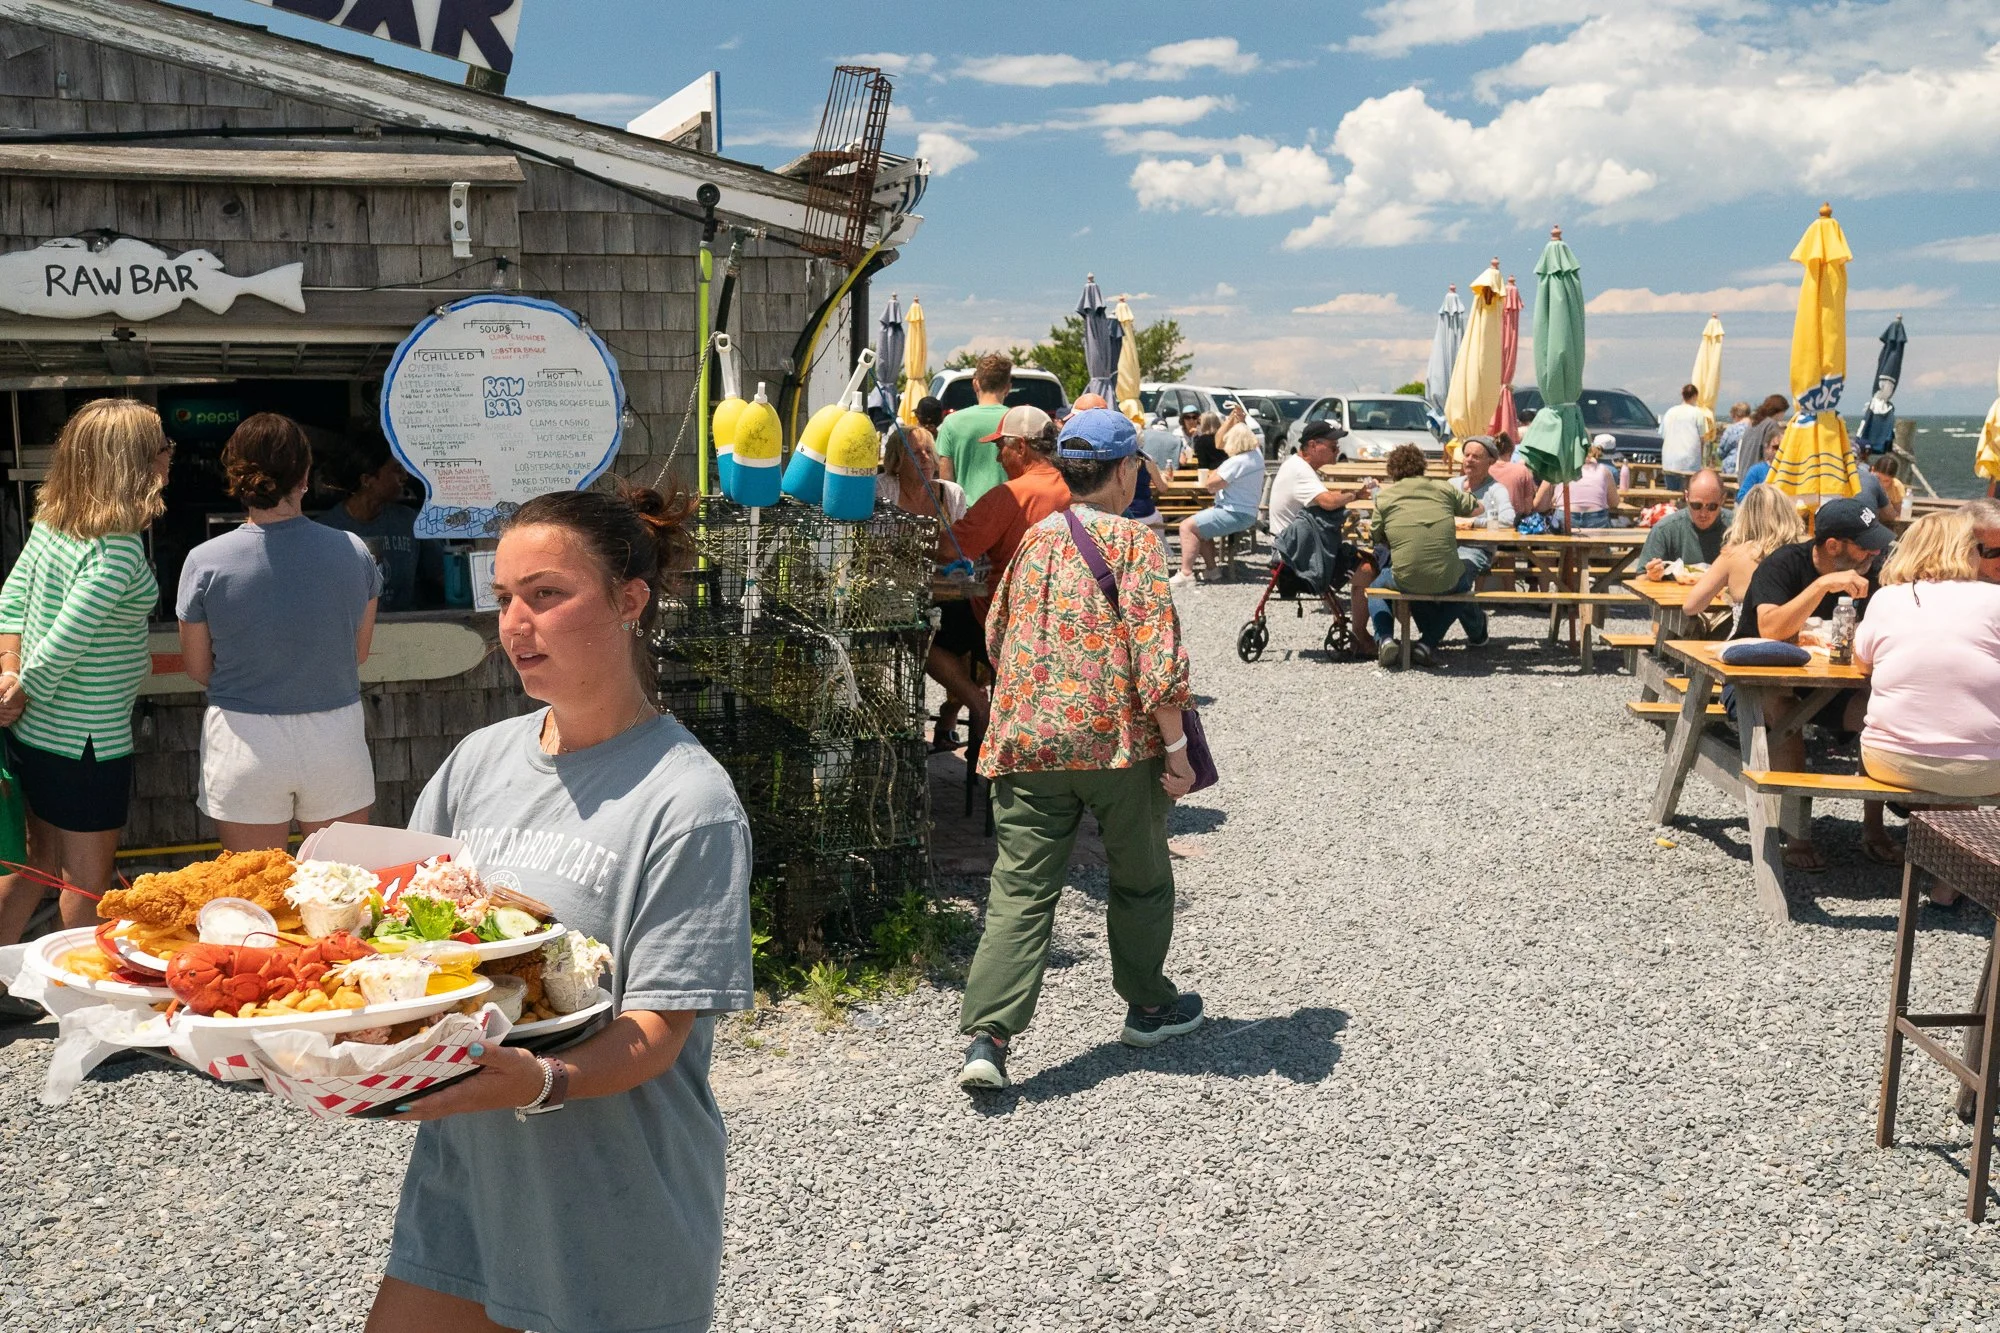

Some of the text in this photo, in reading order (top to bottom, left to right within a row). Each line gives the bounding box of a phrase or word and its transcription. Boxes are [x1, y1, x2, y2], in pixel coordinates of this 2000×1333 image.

[45, 264, 199, 296] RAW BAR
[480, 325, 512, 334] SOUPS
[422, 352, 474, 362] CHILLED
[408, 363, 448, 372] OYSTERS
[547, 372, 565, 380] HOT
[400, 380, 464, 389] LITTLENECKS
[482, 376, 524, 398] RAW
[528, 380, 557, 388] OYSTERS
[526, 399, 558, 407] OYSTERS
[485, 399, 522, 418] BAR
[196, 409, 239, 424] pepsi
[399, 414, 478, 424] COLD SAMPLER
[530, 418, 590, 427] CLAMS CASINO
[537, 434, 553, 442] HOT
[487, 828, 564, 872] HARBOR
[556, 838, 618, 893] CAFE
